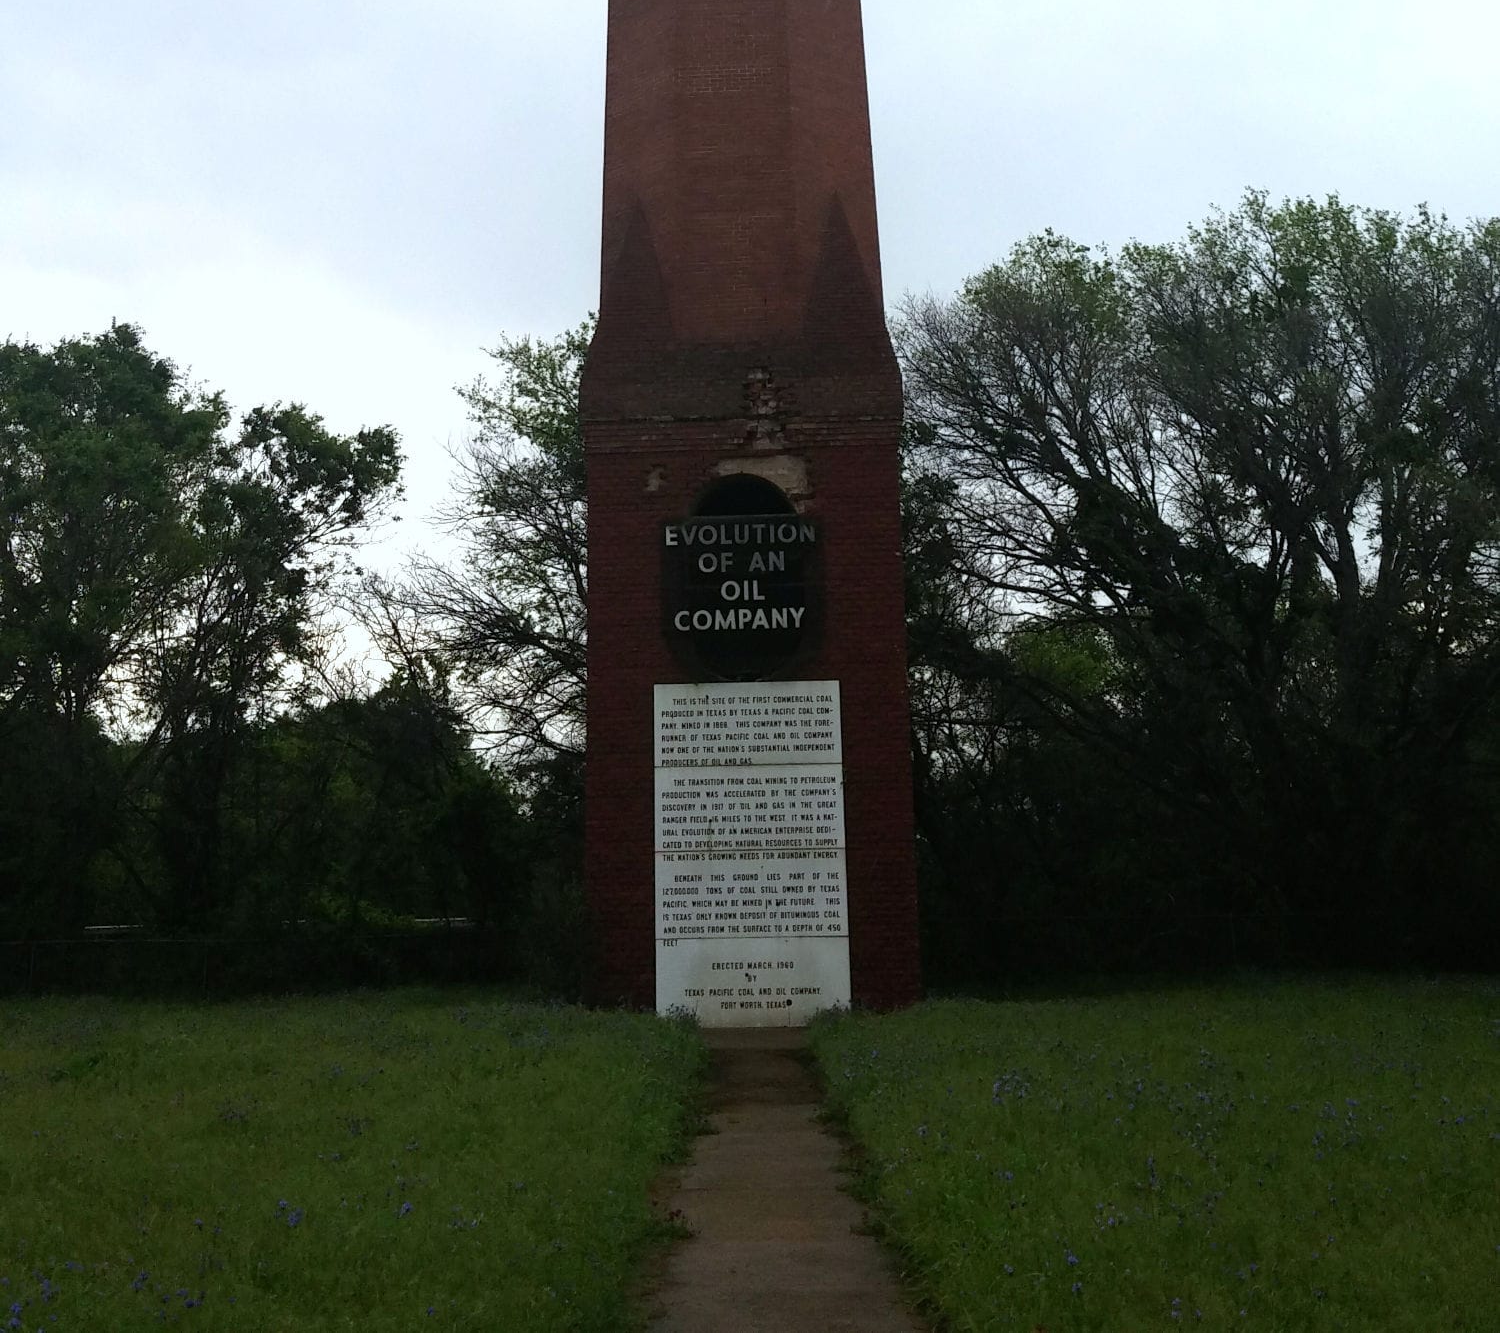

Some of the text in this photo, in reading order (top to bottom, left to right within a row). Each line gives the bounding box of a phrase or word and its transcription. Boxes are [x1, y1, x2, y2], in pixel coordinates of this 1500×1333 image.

[665, 524, 816, 546] EVOLUTION
[699, 551, 785, 573] OF AN
[720, 581, 765, 601] OIL
[674, 608, 805, 631] COMPANY
[662, 710, 694, 718] PRODUCED
[772, 708, 795, 716] PACIFIC
[690, 734, 698, 742] OF
[726, 733, 749, 741] PACIFIC
[790, 732, 800, 740] OIL
[677, 746, 689, 754] ONE
[793, 744, 835, 752] INDEPENDENT
[701, 758, 709, 766] OF
[688, 778, 725, 786] TRANSITION
[766, 777, 788, 785] MINING
[801, 776, 836, 784] PETROLEUM
[662, 791, 700, 799] PRODUCTION
[724, 790, 766, 798] ACCELERATED
[785, 789, 796, 797] THE
[700, 803, 707, 811] IN
[755, 802, 768, 810] AND
[662, 816, 689, 824] RANGER
[722, 815, 741, 823] MILES
[662, 841, 682, 849] CATED
[695, 840, 733, 848] DEVELOPING
[765, 839, 802, 847] RESOURCES
[708, 853, 736, 861] GROWING
[710, 874, 725, 882] THIS
[767, 873, 781, 881] LIES
[706, 887, 723, 895] TONS
[761, 886, 778, 894] STILL
[820, 885, 840, 893] TEXAS
[663, 900, 688, 908] PACIFIC
[742, 899, 762, 907] MINED
[672, 913, 692, 921] TEXAS
[740, 912, 766, 920] DEPOSIT
[780, 911, 819, 919] BITUMINOUS
[679, 926, 704, 934] OCCURS
[743, 925, 771, 933] SURFACE
[792, 924, 813, 932] DEPTH
[816, 924, 824, 932] OF
[827, 924, 841, 932] 450
[712, 962, 744, 970] ERECTED
[685, 989, 704, 997] TEXAS
[759, 988, 772, 996] AND
[776, 988, 787, 996] OIL
[720, 1002, 737, 1010] FORT
